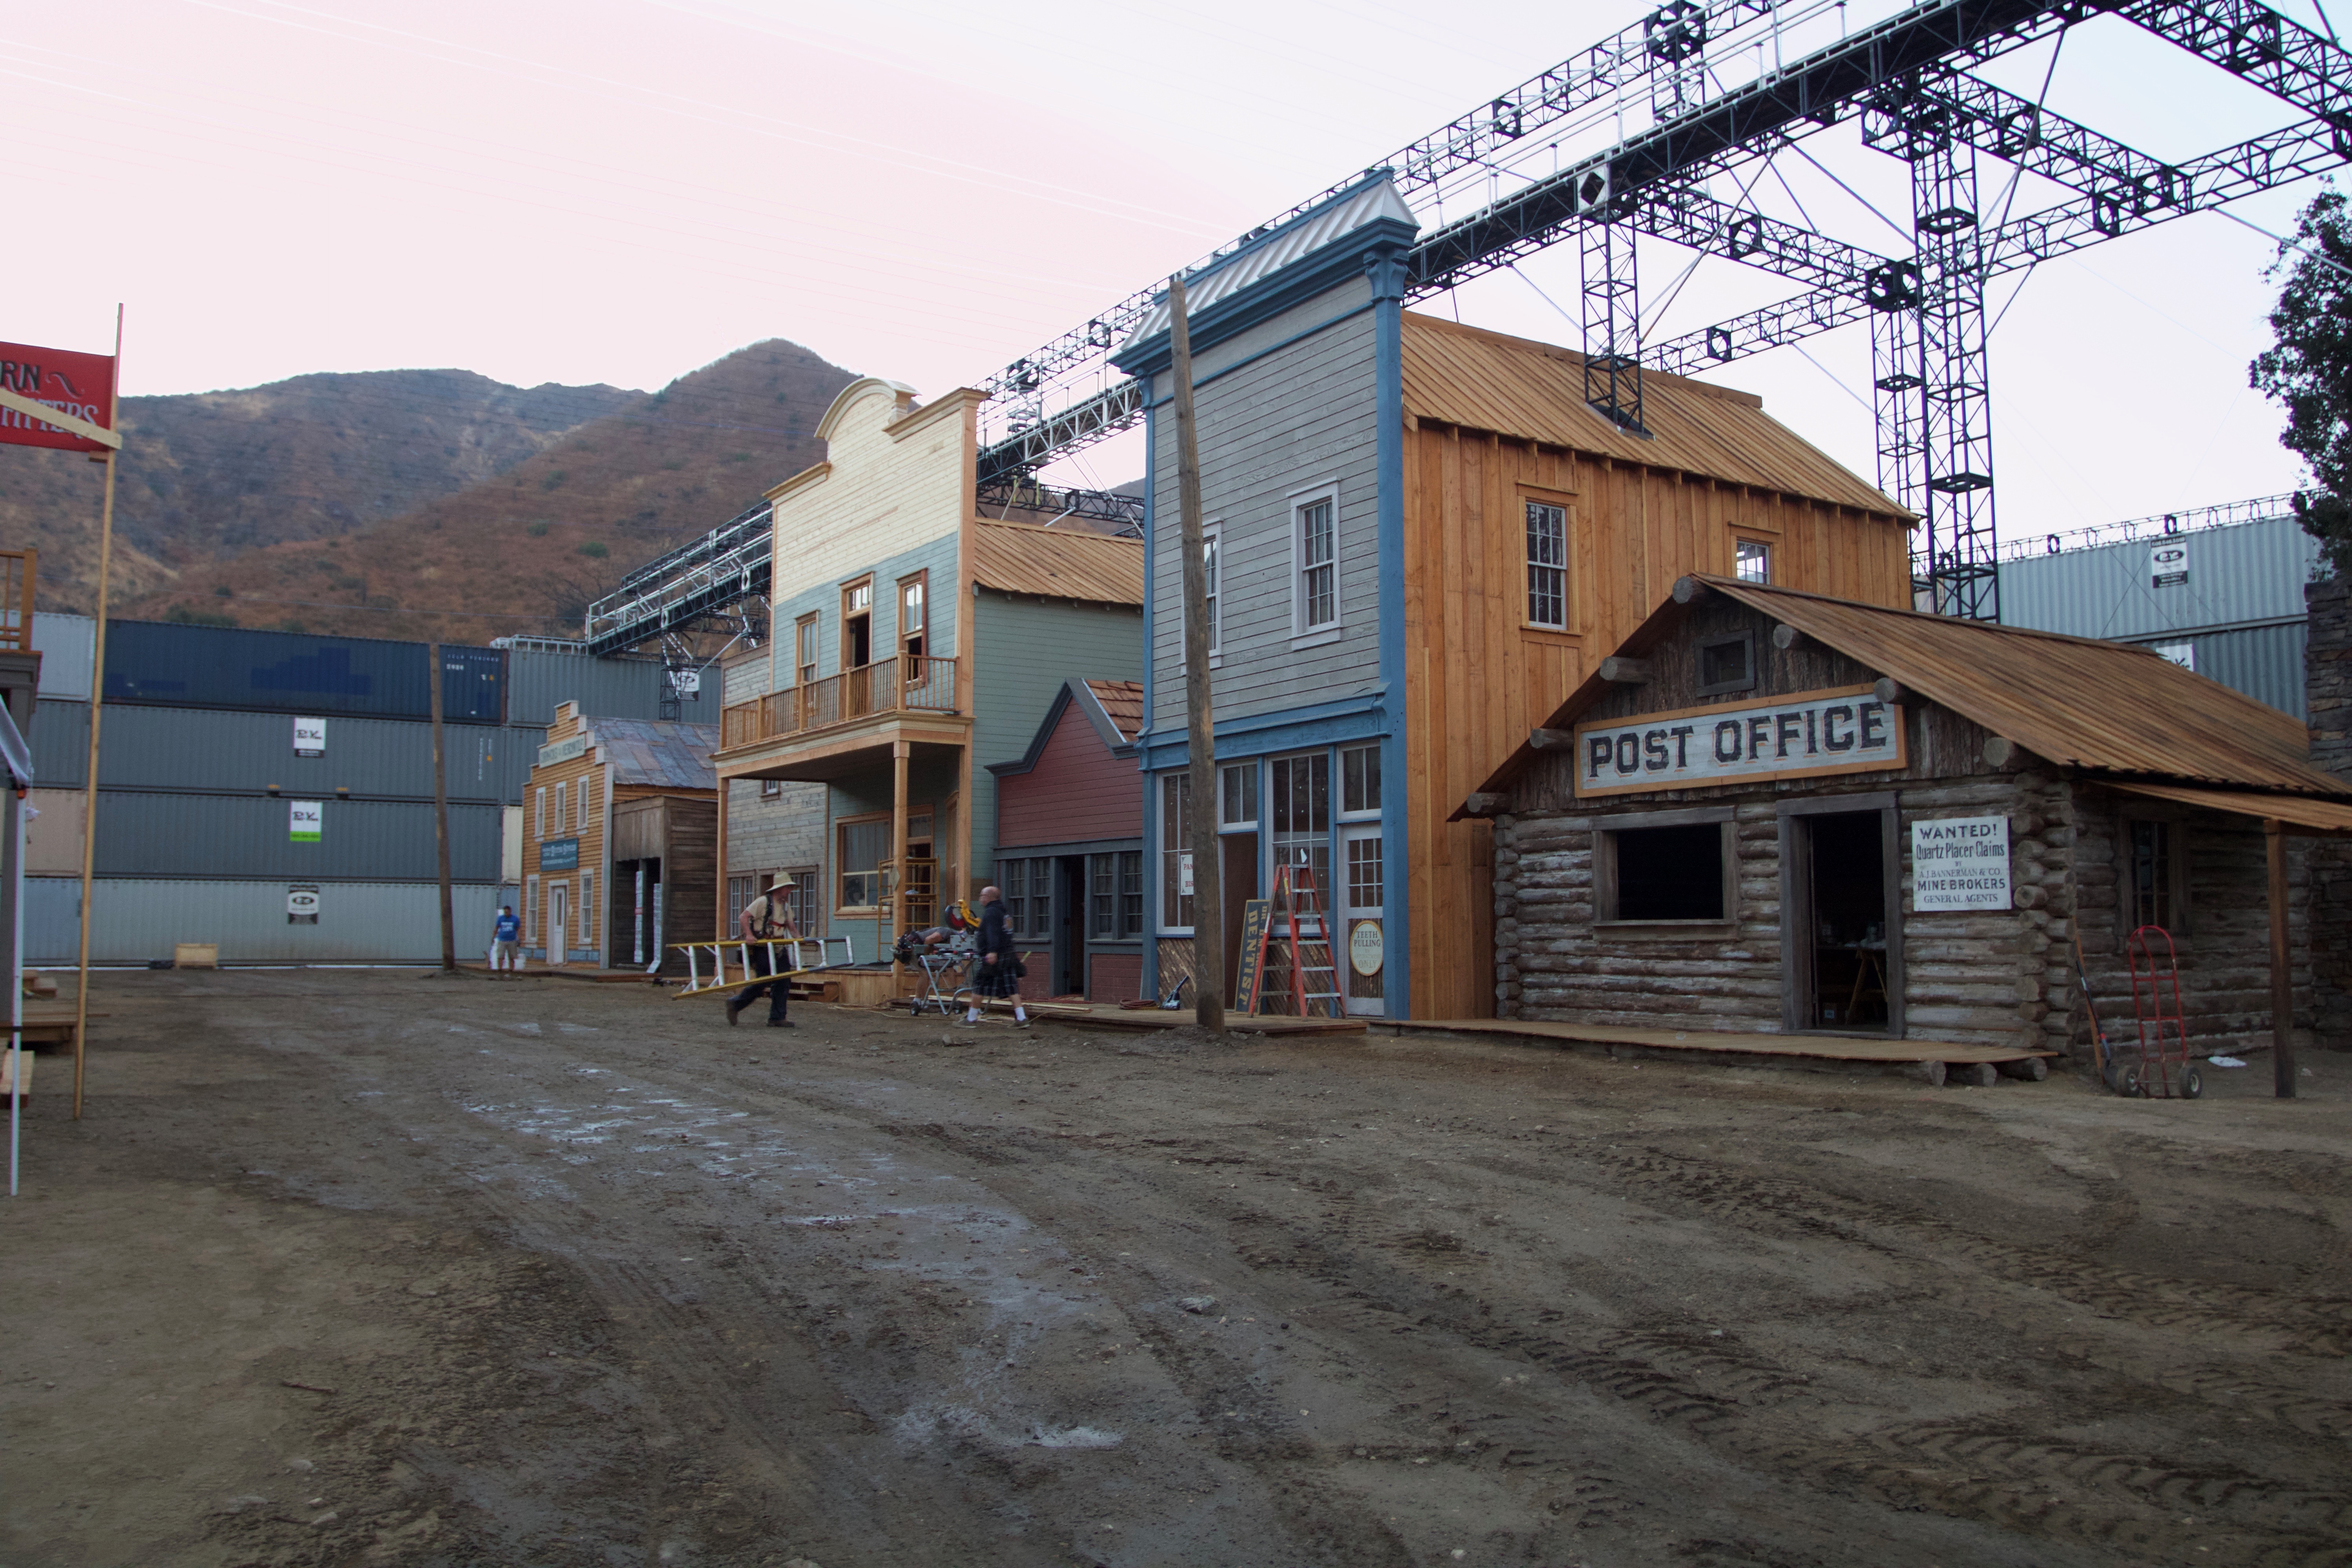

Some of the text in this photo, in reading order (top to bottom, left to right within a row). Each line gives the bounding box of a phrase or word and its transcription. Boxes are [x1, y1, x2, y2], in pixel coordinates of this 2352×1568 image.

[1588, 702, 1887, 779] POST OFFICE
[1919, 824, 1997, 839] WANTED!
[1916, 840, 2005, 860] Quartz Placer Claims
[1918, 878, 2005, 891] MINE BROKERS
[1924, 893, 1998, 904] GENERAL AGENTS
[1239, 909, 1258, 1005] DENTIST
[1359, 959, 1377, 968] ONLY
